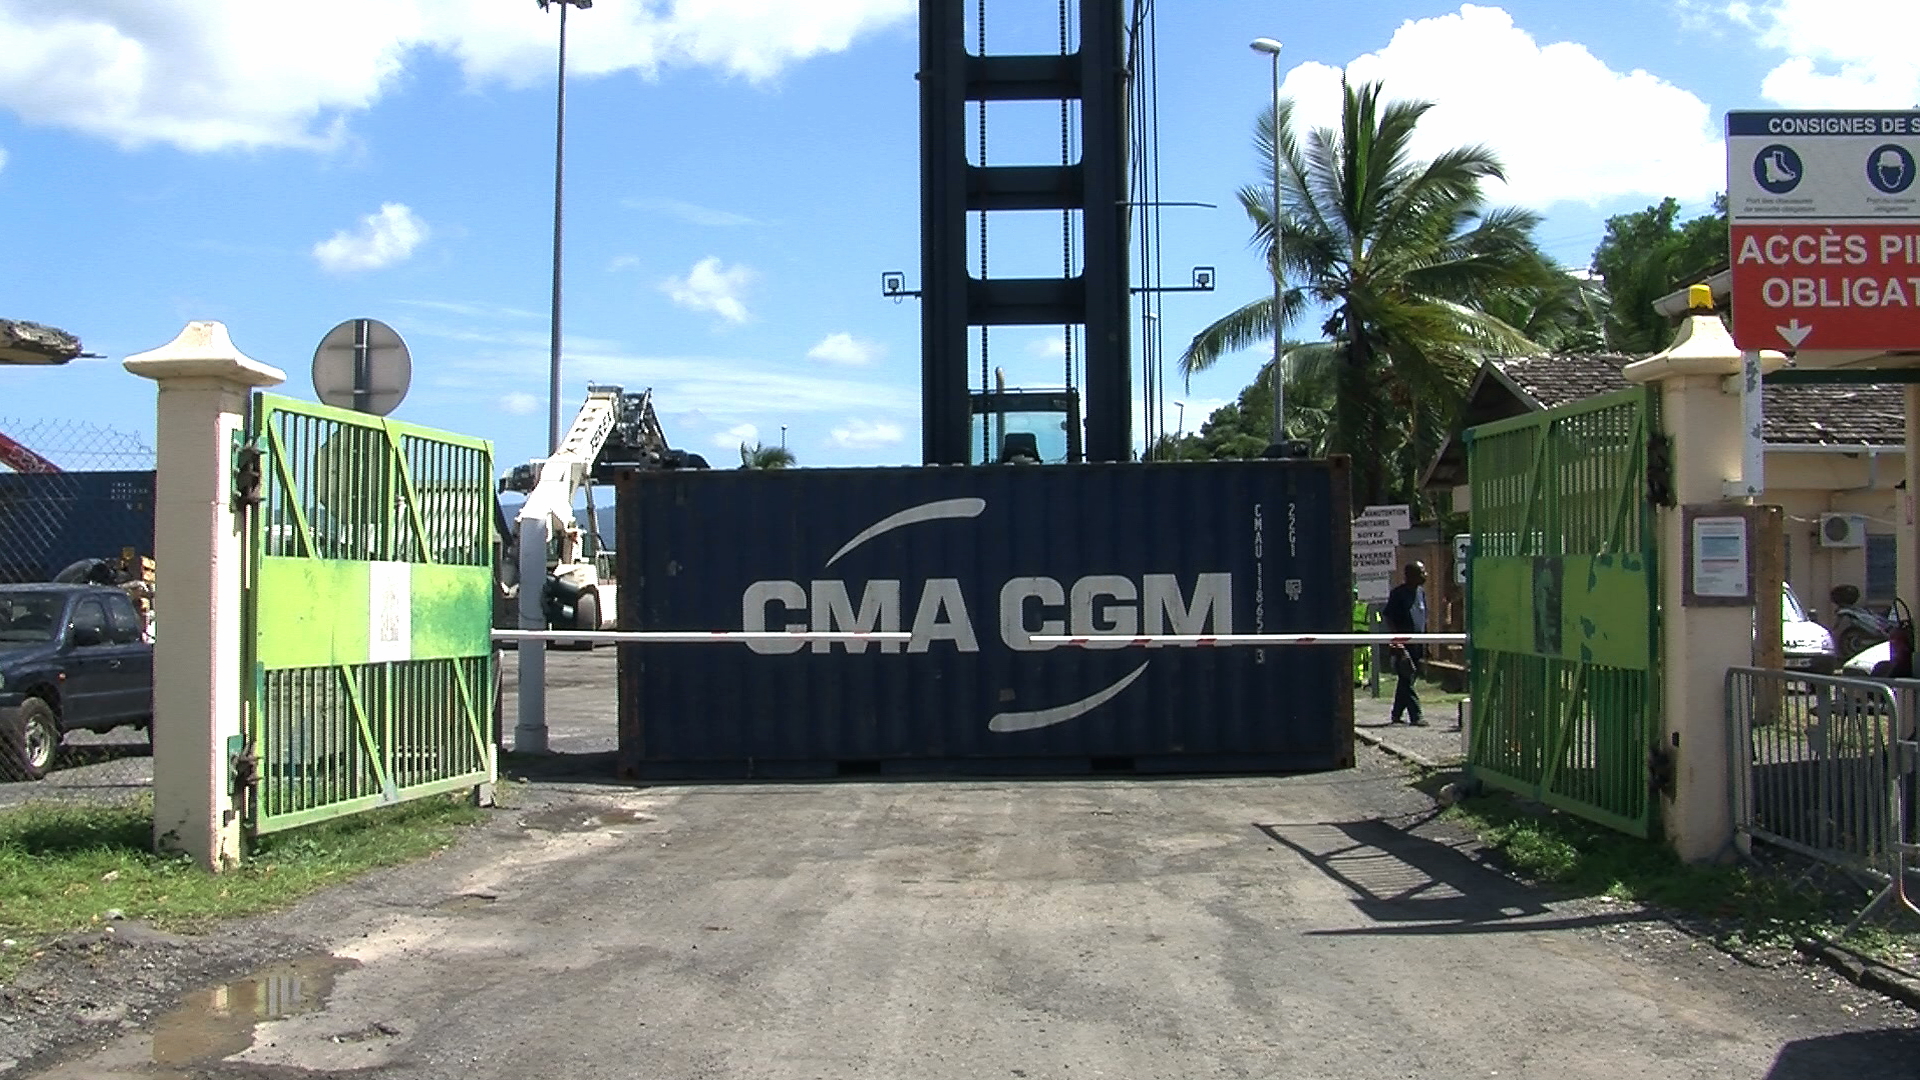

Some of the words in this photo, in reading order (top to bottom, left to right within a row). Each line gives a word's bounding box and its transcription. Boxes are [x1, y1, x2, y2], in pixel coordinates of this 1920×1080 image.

[1768, 117, 1877, 133] CONSIGNES
[1881, 117, 1907, 133] DE
[1737, 228, 1868, 265] ACCÈS
[1880, 235, 1920, 264] PI
[1254, 503, 1263, 558] CMAU
[1287, 503, 1297, 557] 22G1
[742, 578, 980, 655] CMA
[1000, 572, 1232, 652] CGM
[1255, 563, 1264, 634] 11865
